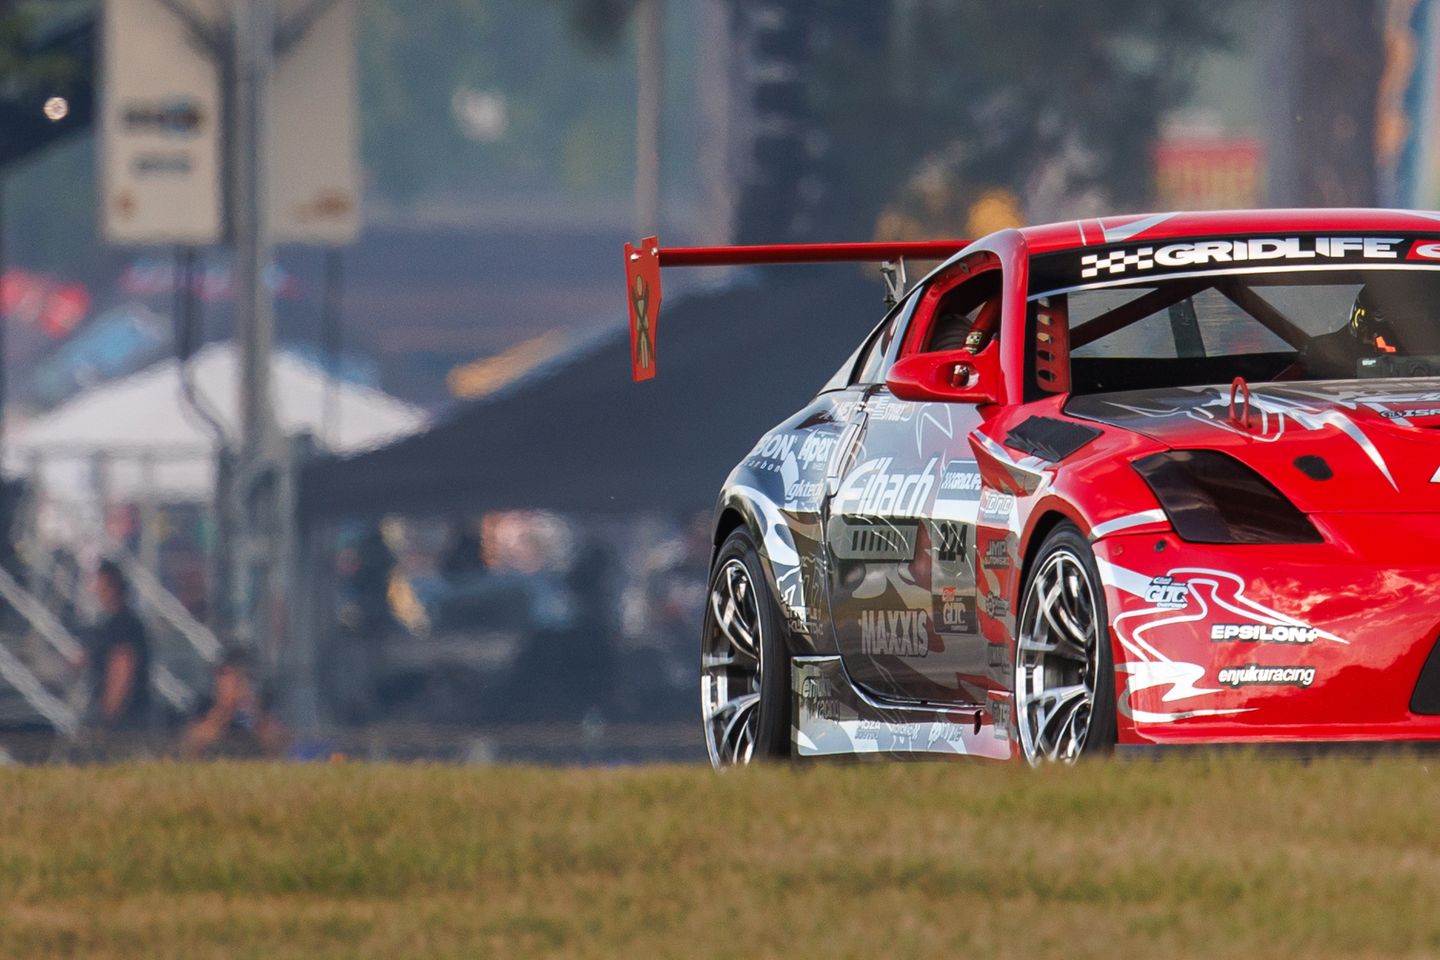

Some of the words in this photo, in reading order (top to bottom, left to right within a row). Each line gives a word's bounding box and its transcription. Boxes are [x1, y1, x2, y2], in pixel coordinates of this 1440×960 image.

[1154, 237, 1405, 266] GRIDLIFE
[831, 457, 938, 518] Eibach
[860, 609, 929, 658] MAXXIS
[1210, 624, 1318, 643] EPSILON+
